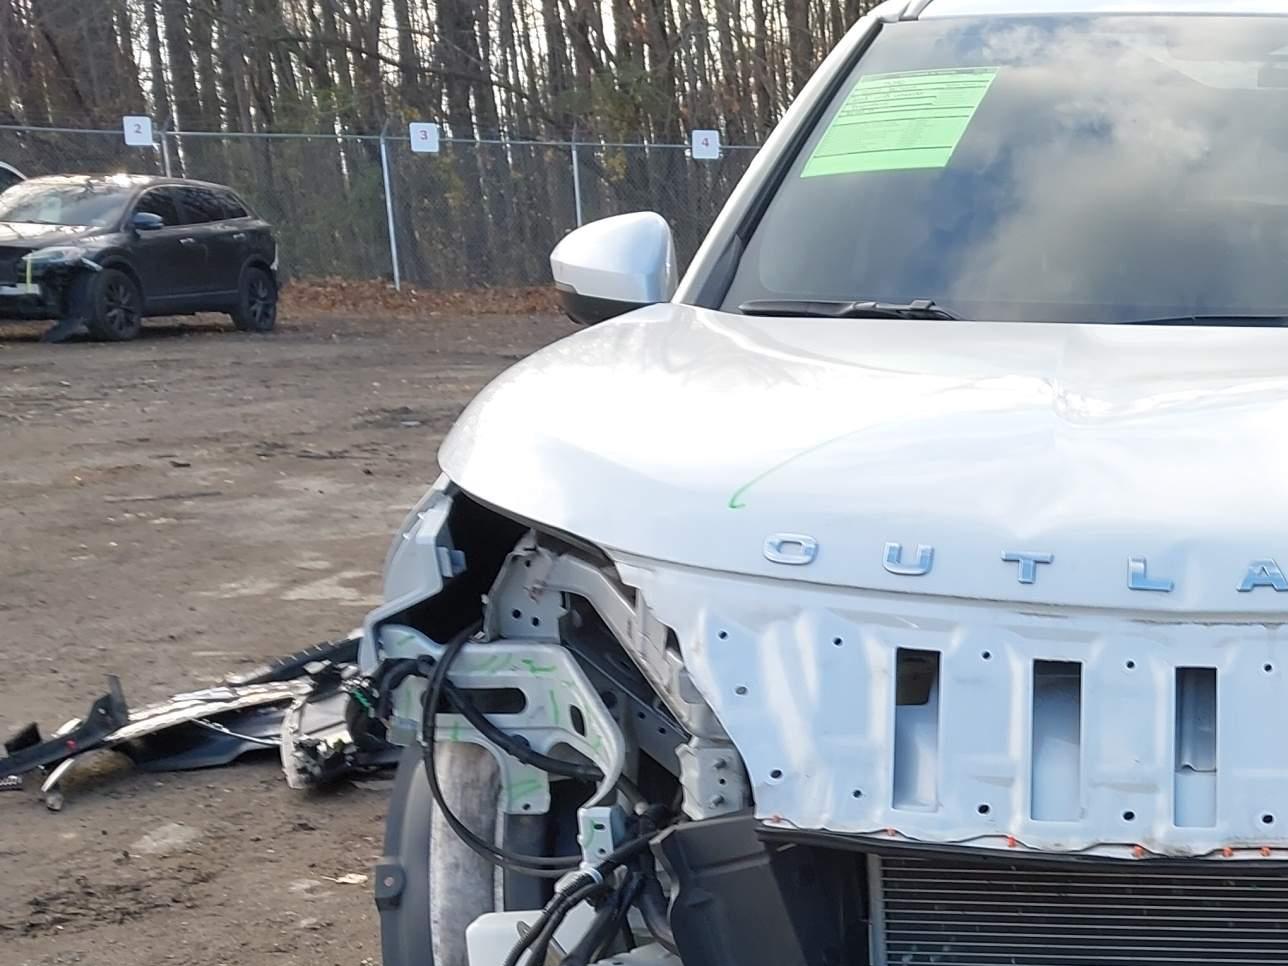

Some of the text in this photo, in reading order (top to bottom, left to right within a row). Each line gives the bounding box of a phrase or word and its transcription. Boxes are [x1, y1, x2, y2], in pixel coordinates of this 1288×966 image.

[133, 123, 142, 134] 2
[419, 129, 428, 140] 3
[701, 137, 709, 146] 4
